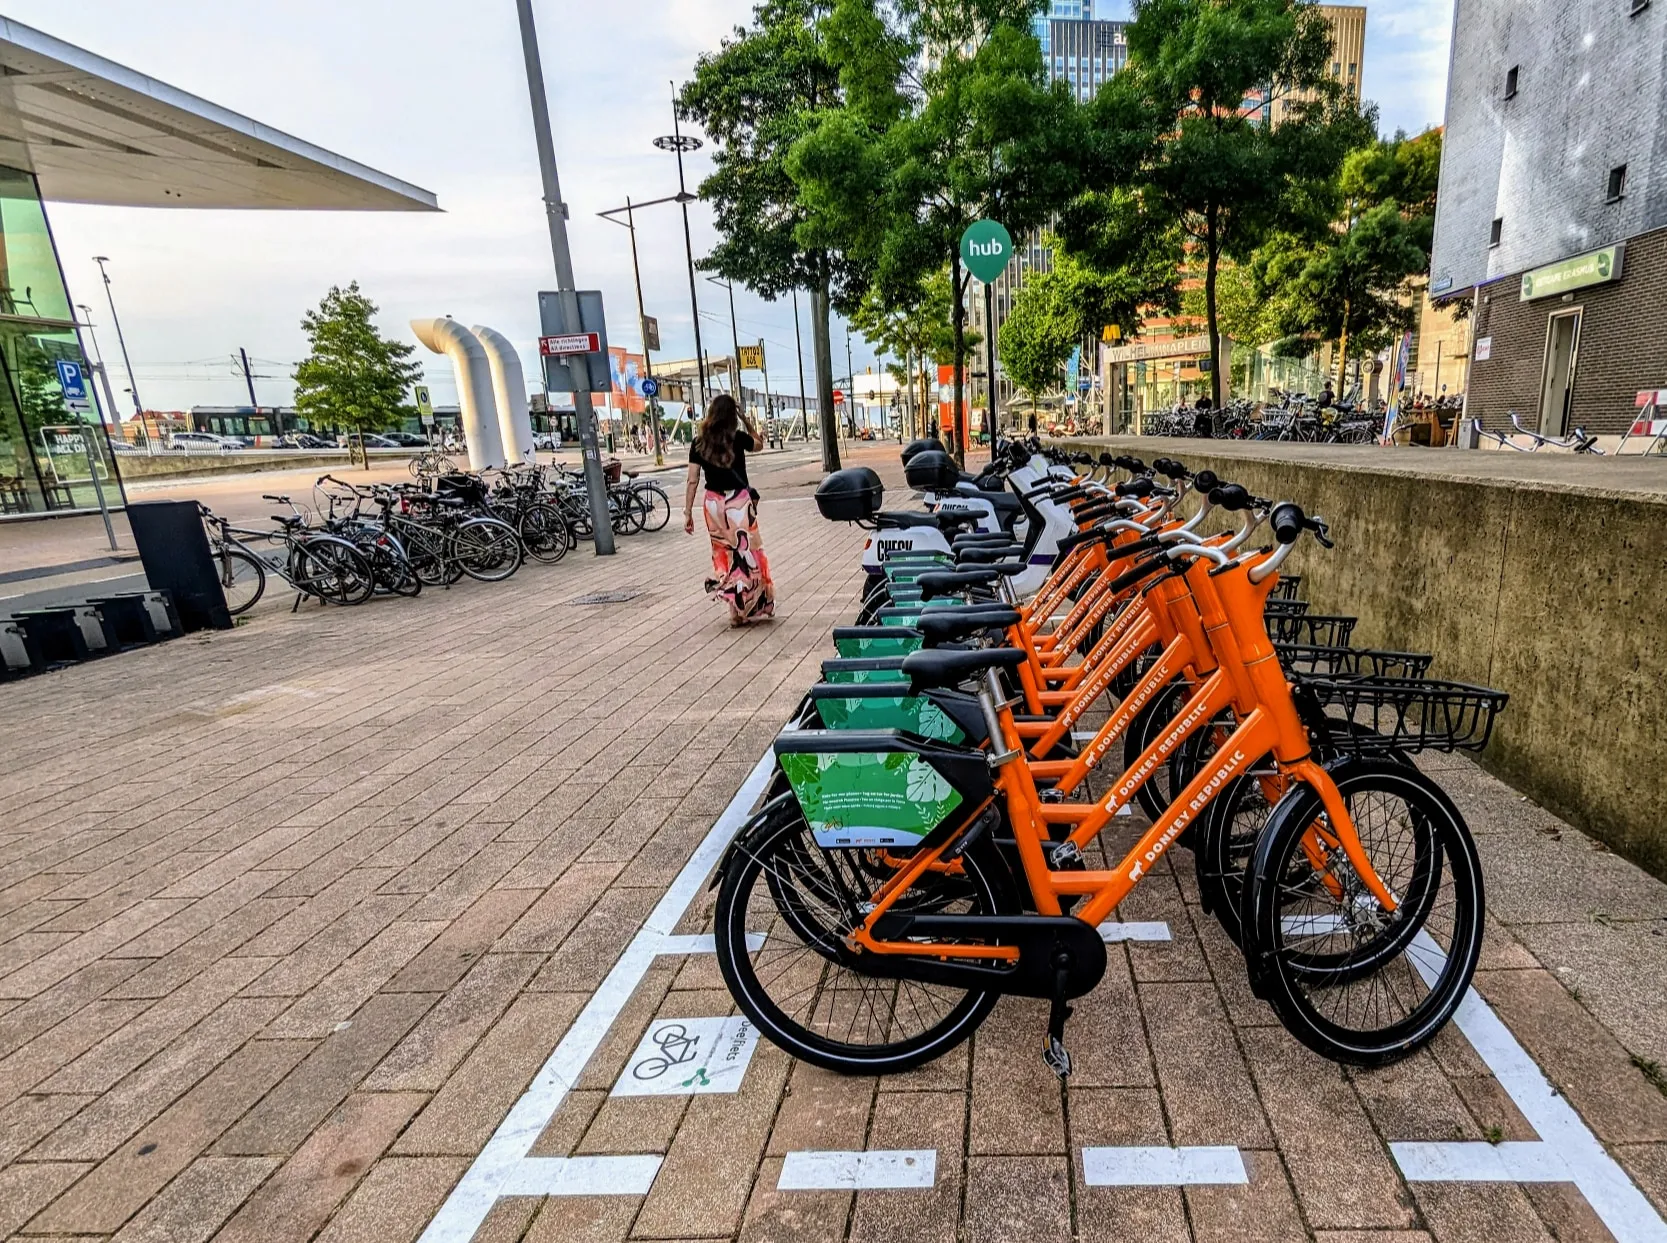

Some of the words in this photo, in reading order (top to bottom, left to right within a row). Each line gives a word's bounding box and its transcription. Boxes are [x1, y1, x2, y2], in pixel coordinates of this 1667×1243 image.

[969, 237, 1003, 257] hub
[62, 364, 77, 384] P
[1112, 338, 1210, 361] WILHELMINAPLEIN
[55, 433, 85, 444] HAPPY
[56, 444, 72, 454] ALL
[1063, 604, 1085, 630] DONKEY
[1084, 576, 1110, 606] REPUBLIC
[1071, 619, 1095, 645] DONKEY
[1093, 593, 1116, 619] REPUBL
[1092, 634, 1117, 662] DONKEY
[1116, 598, 1145, 633] REPUBLIC
[1073, 679, 1104, 714] DONKEY
[1102, 639, 1140, 680] REPUBLIC
[1097, 712, 1130, 752] DONKEY
[1129, 666, 1169, 713] REPUBLIC
[1119, 752, 1159, 796] DONKEY
[1158, 703, 1207, 753] REPUBLIC
[1144, 810, 1190, 862] DONKEY
[1189, 750, 1245, 811] REPUBLIC
[726, 1020, 751, 1061] Deelfiets
